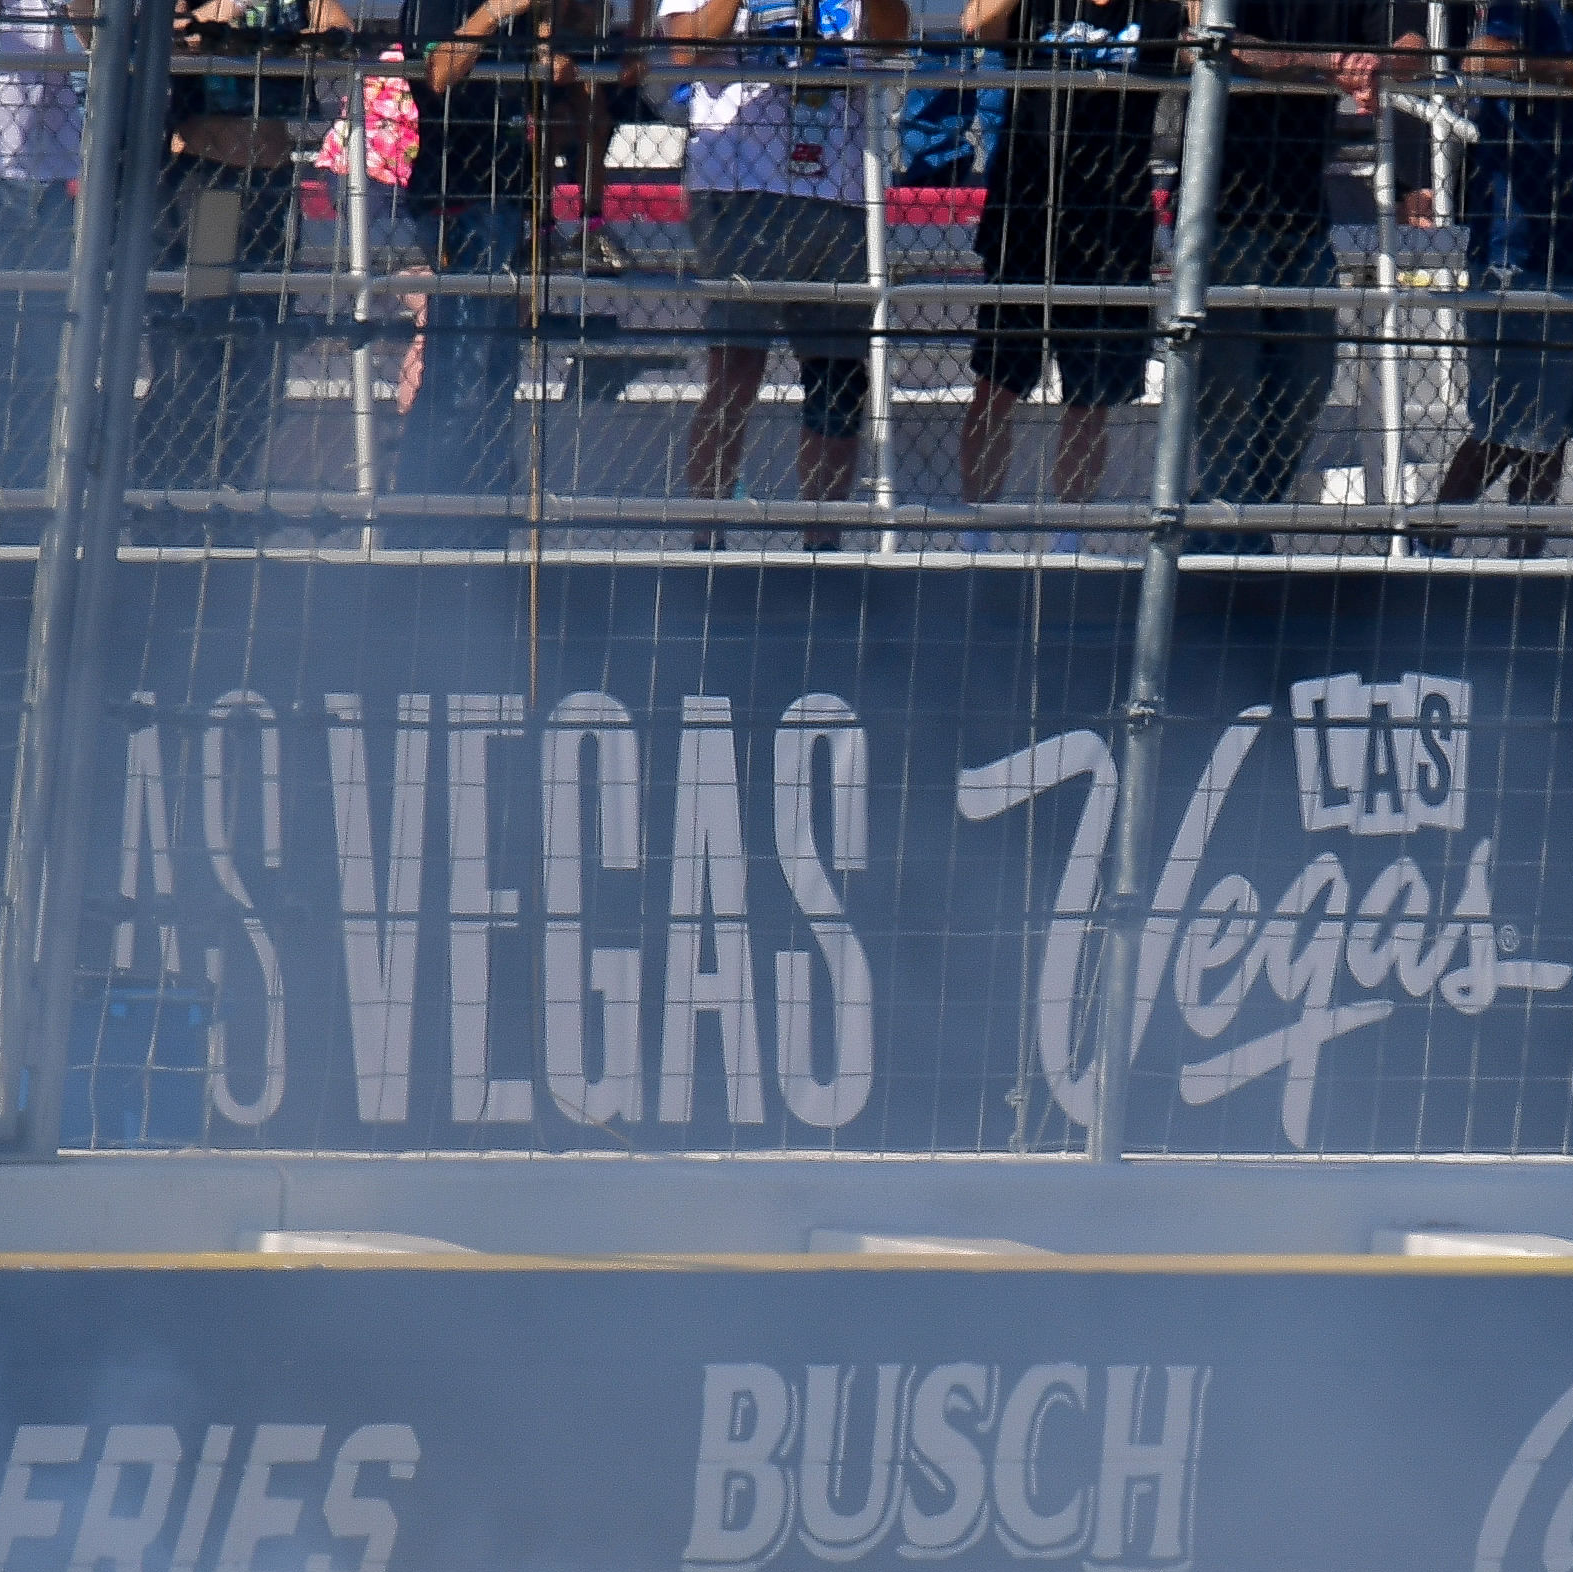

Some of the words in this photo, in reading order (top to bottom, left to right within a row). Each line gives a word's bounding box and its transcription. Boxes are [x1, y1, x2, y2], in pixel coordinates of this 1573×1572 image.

[116, 690, 286, 1126] AS
[324, 690, 874, 1128] VEGAS
[958, 704, 1573, 1148] Vegas
[1296, 683, 1462, 820] LAS
